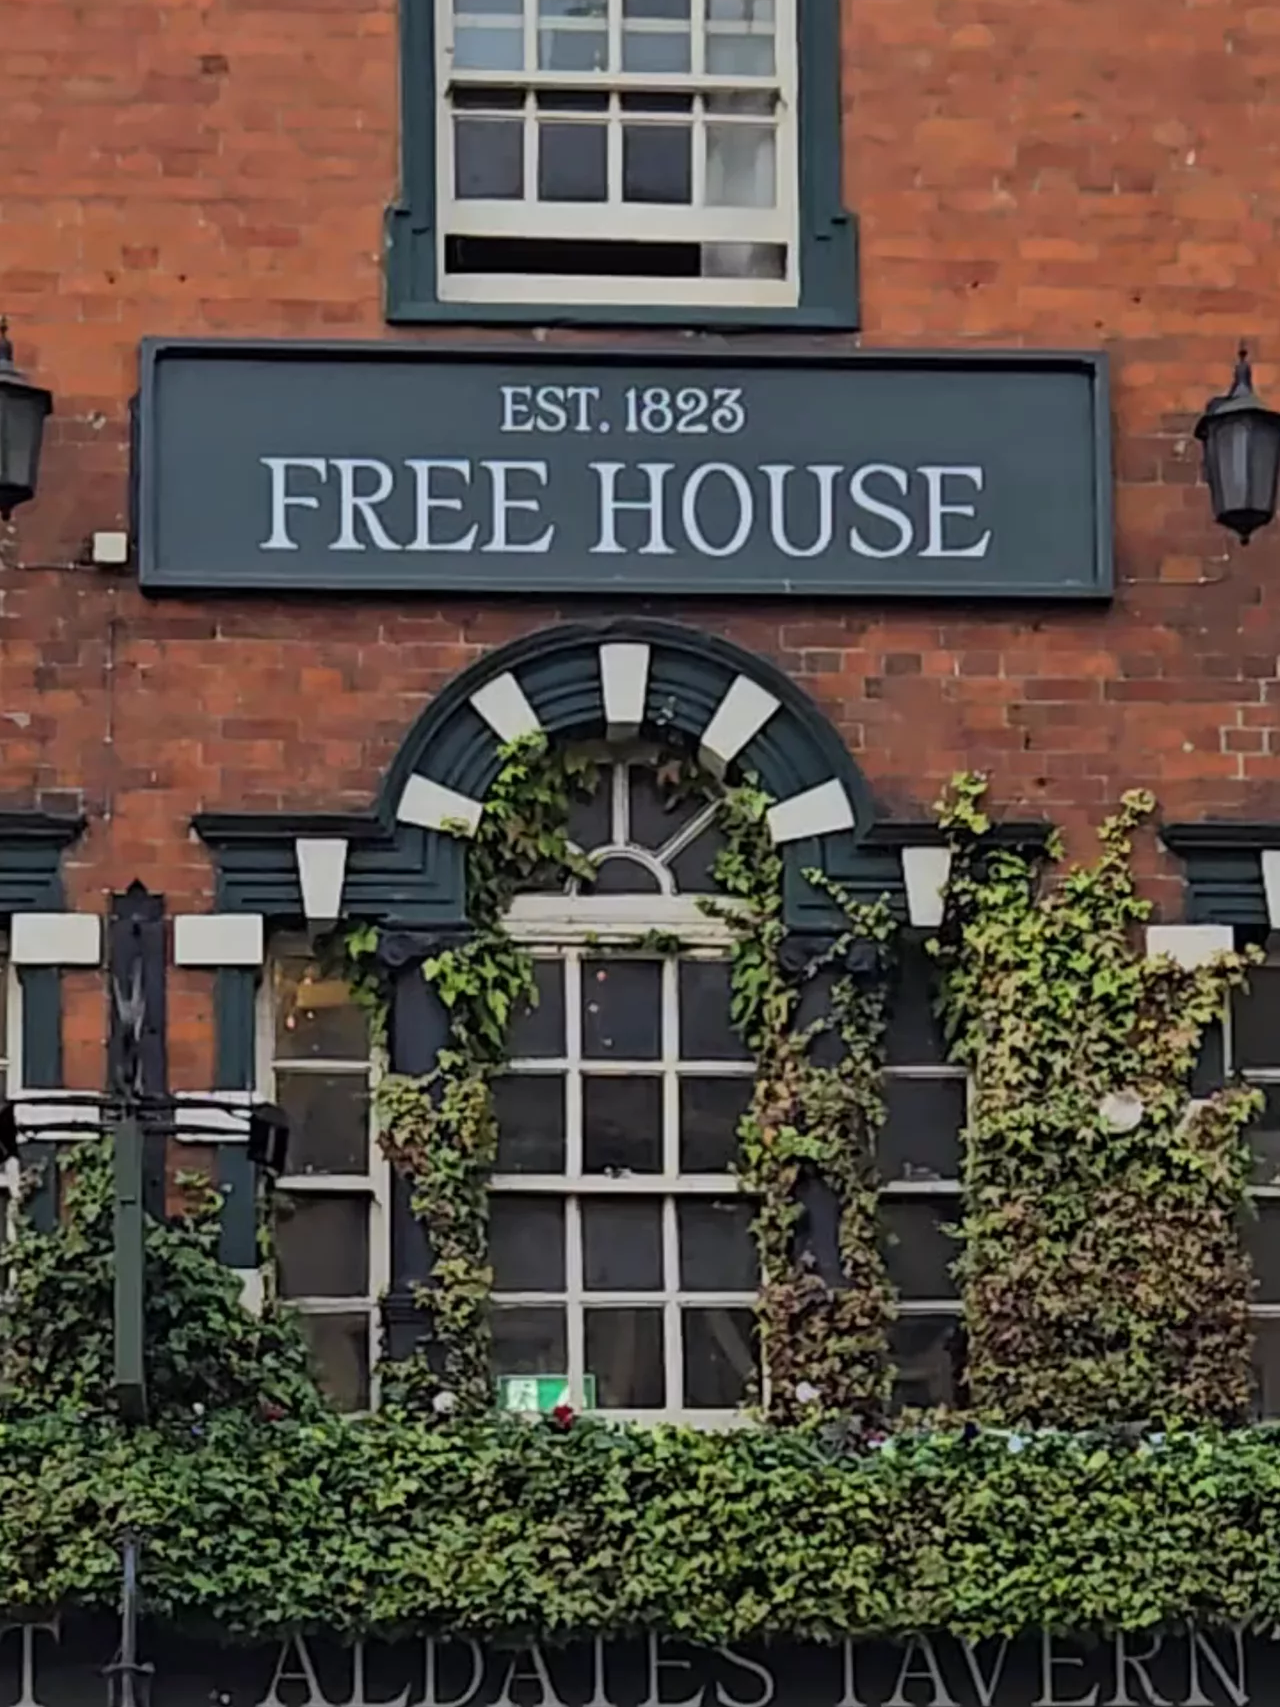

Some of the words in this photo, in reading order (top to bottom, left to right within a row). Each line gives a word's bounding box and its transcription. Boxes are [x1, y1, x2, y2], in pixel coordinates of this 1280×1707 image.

[500, 385, 611, 434] EST.
[625, 387, 746, 434] 1823
[259, 456, 555, 553] FREE
[588, 461, 992, 558] HOUSE
[834, 1617, 1251, 1707] TAVERN
